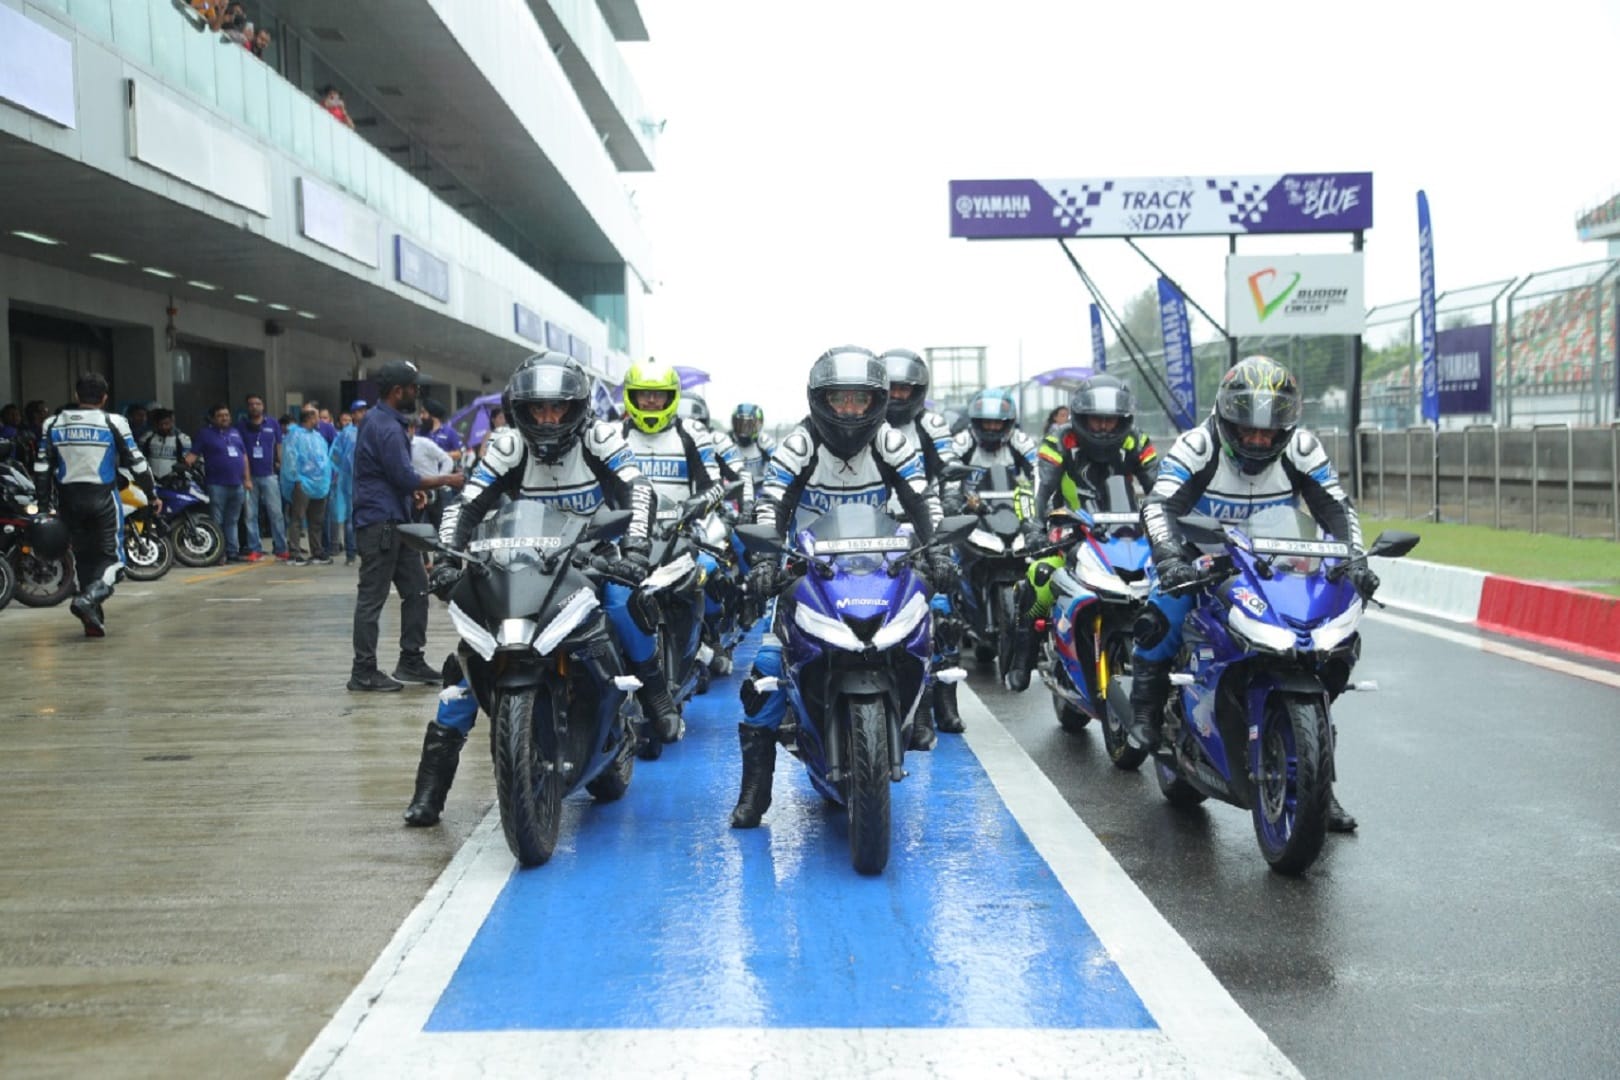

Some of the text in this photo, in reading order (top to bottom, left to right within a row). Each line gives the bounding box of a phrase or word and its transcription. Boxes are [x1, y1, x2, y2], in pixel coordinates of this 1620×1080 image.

[972, 194, 1031, 213] YAMAHA
[1122, 190, 1195, 209] TRACK
[1302, 184, 1361, 219] BLUE
[1143, 212, 1191, 230] DAY
[1161, 299, 1185, 391] YAMAHA
[630, 484, 652, 539] YAMAHA
